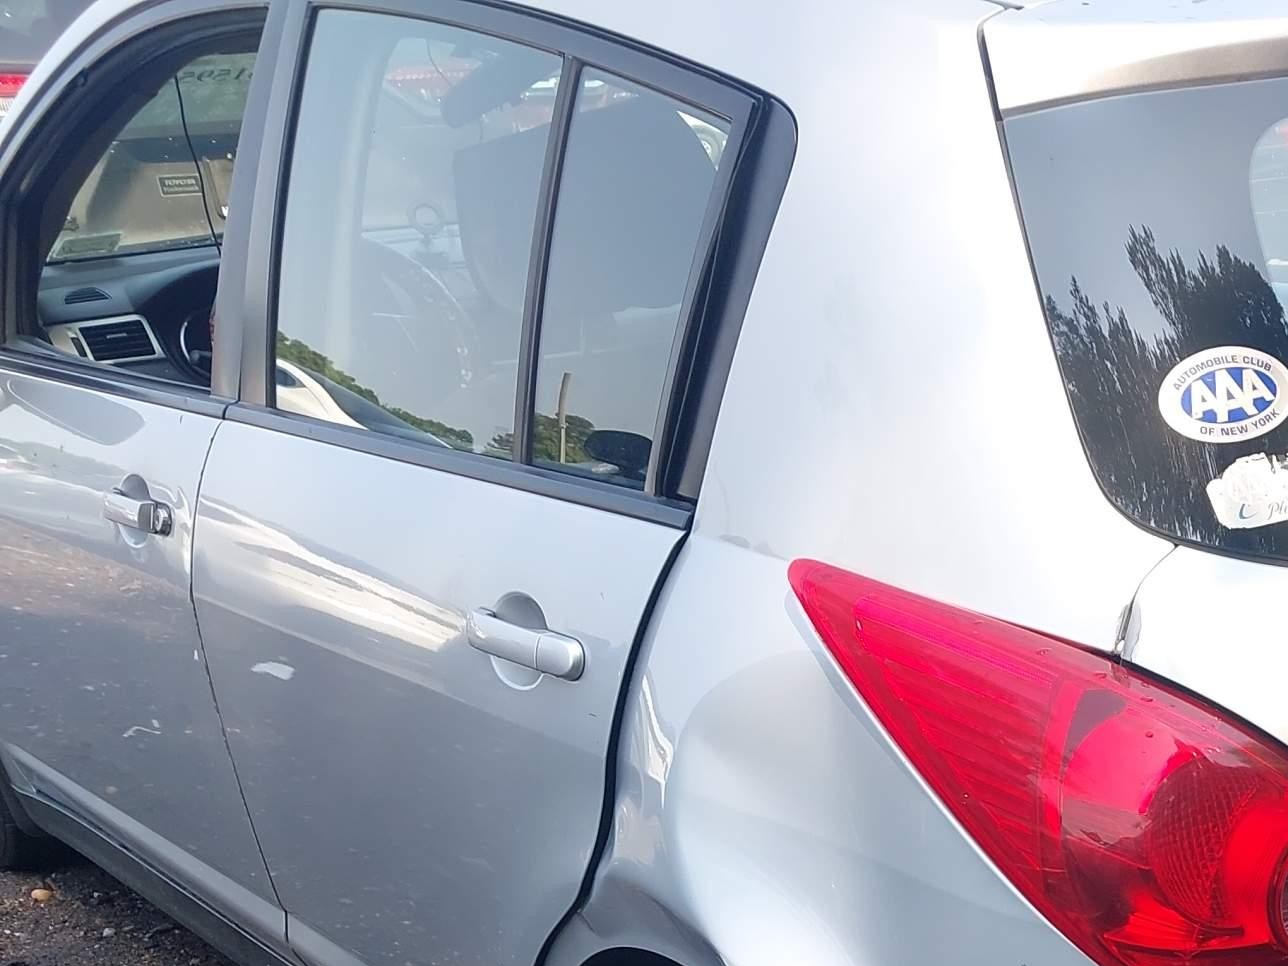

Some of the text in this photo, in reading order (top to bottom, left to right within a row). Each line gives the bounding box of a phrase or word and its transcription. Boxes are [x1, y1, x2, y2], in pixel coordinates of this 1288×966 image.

[1173, 355, 1272, 390] AUTOMOBILE CLUB
[1191, 368, 1276, 423] AAA
[1200, 408, 1280, 436] OF NEW YORK
